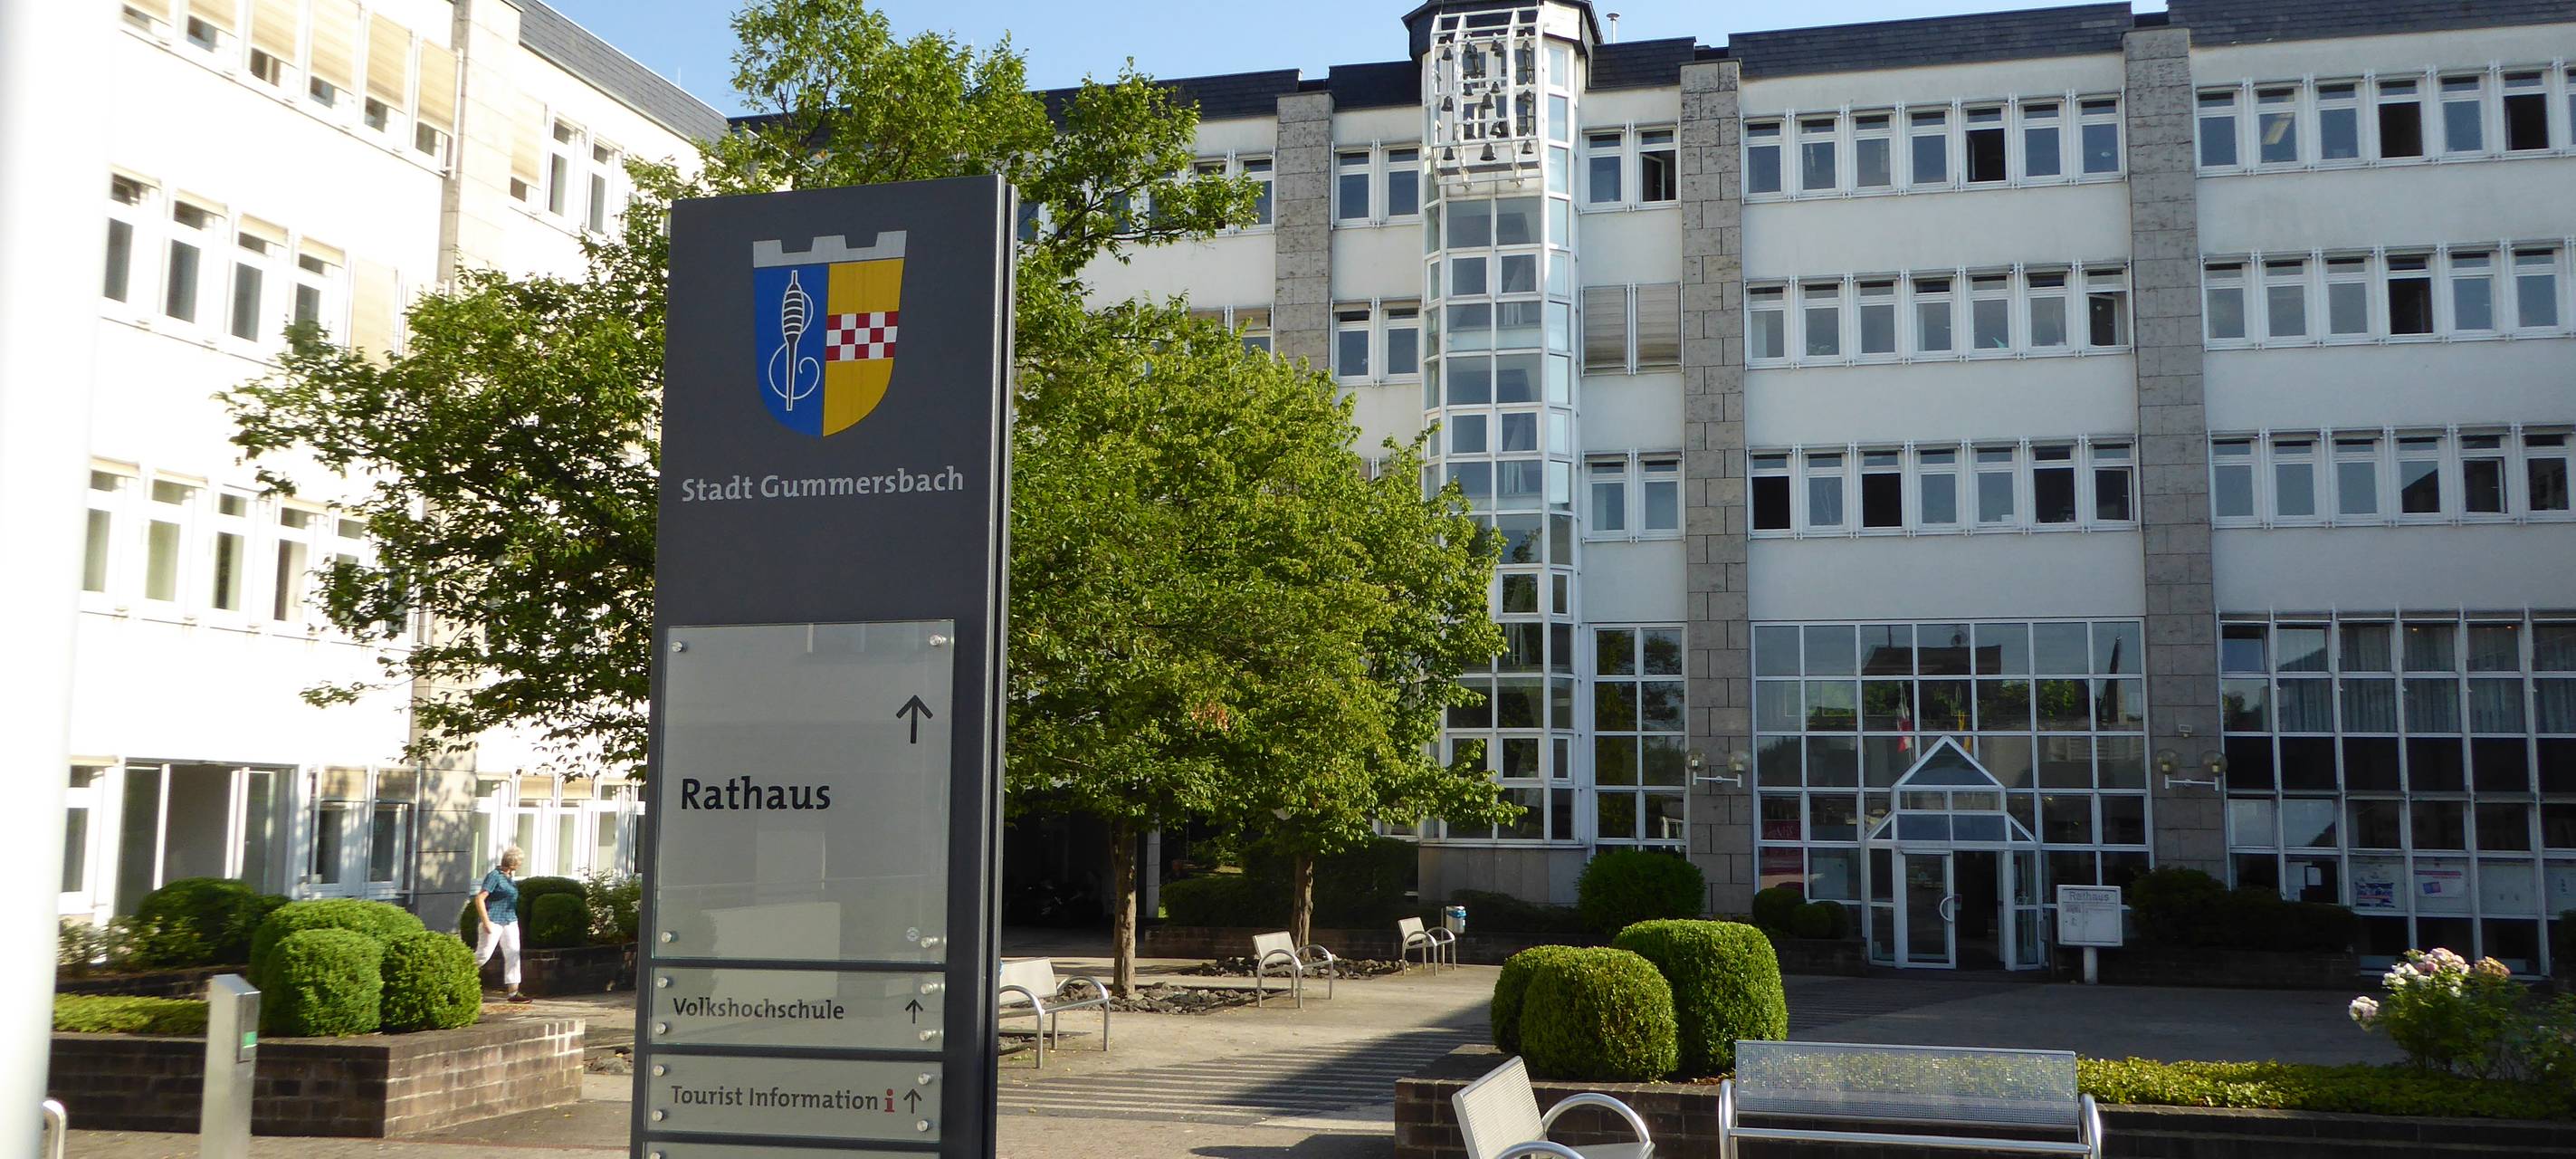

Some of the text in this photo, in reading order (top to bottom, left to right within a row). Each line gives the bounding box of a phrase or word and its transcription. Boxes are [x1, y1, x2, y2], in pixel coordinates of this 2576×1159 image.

[682, 465, 964, 503] Stadt Gummersbach
[681, 776, 831, 809] Rathaus
[2069, 891, 2109, 901] Rathaus
[673, 997, 844, 1020] Volkshochschule
[672, 1086, 742, 1106] Tourist
[749, 1087, 878, 1110] Information
